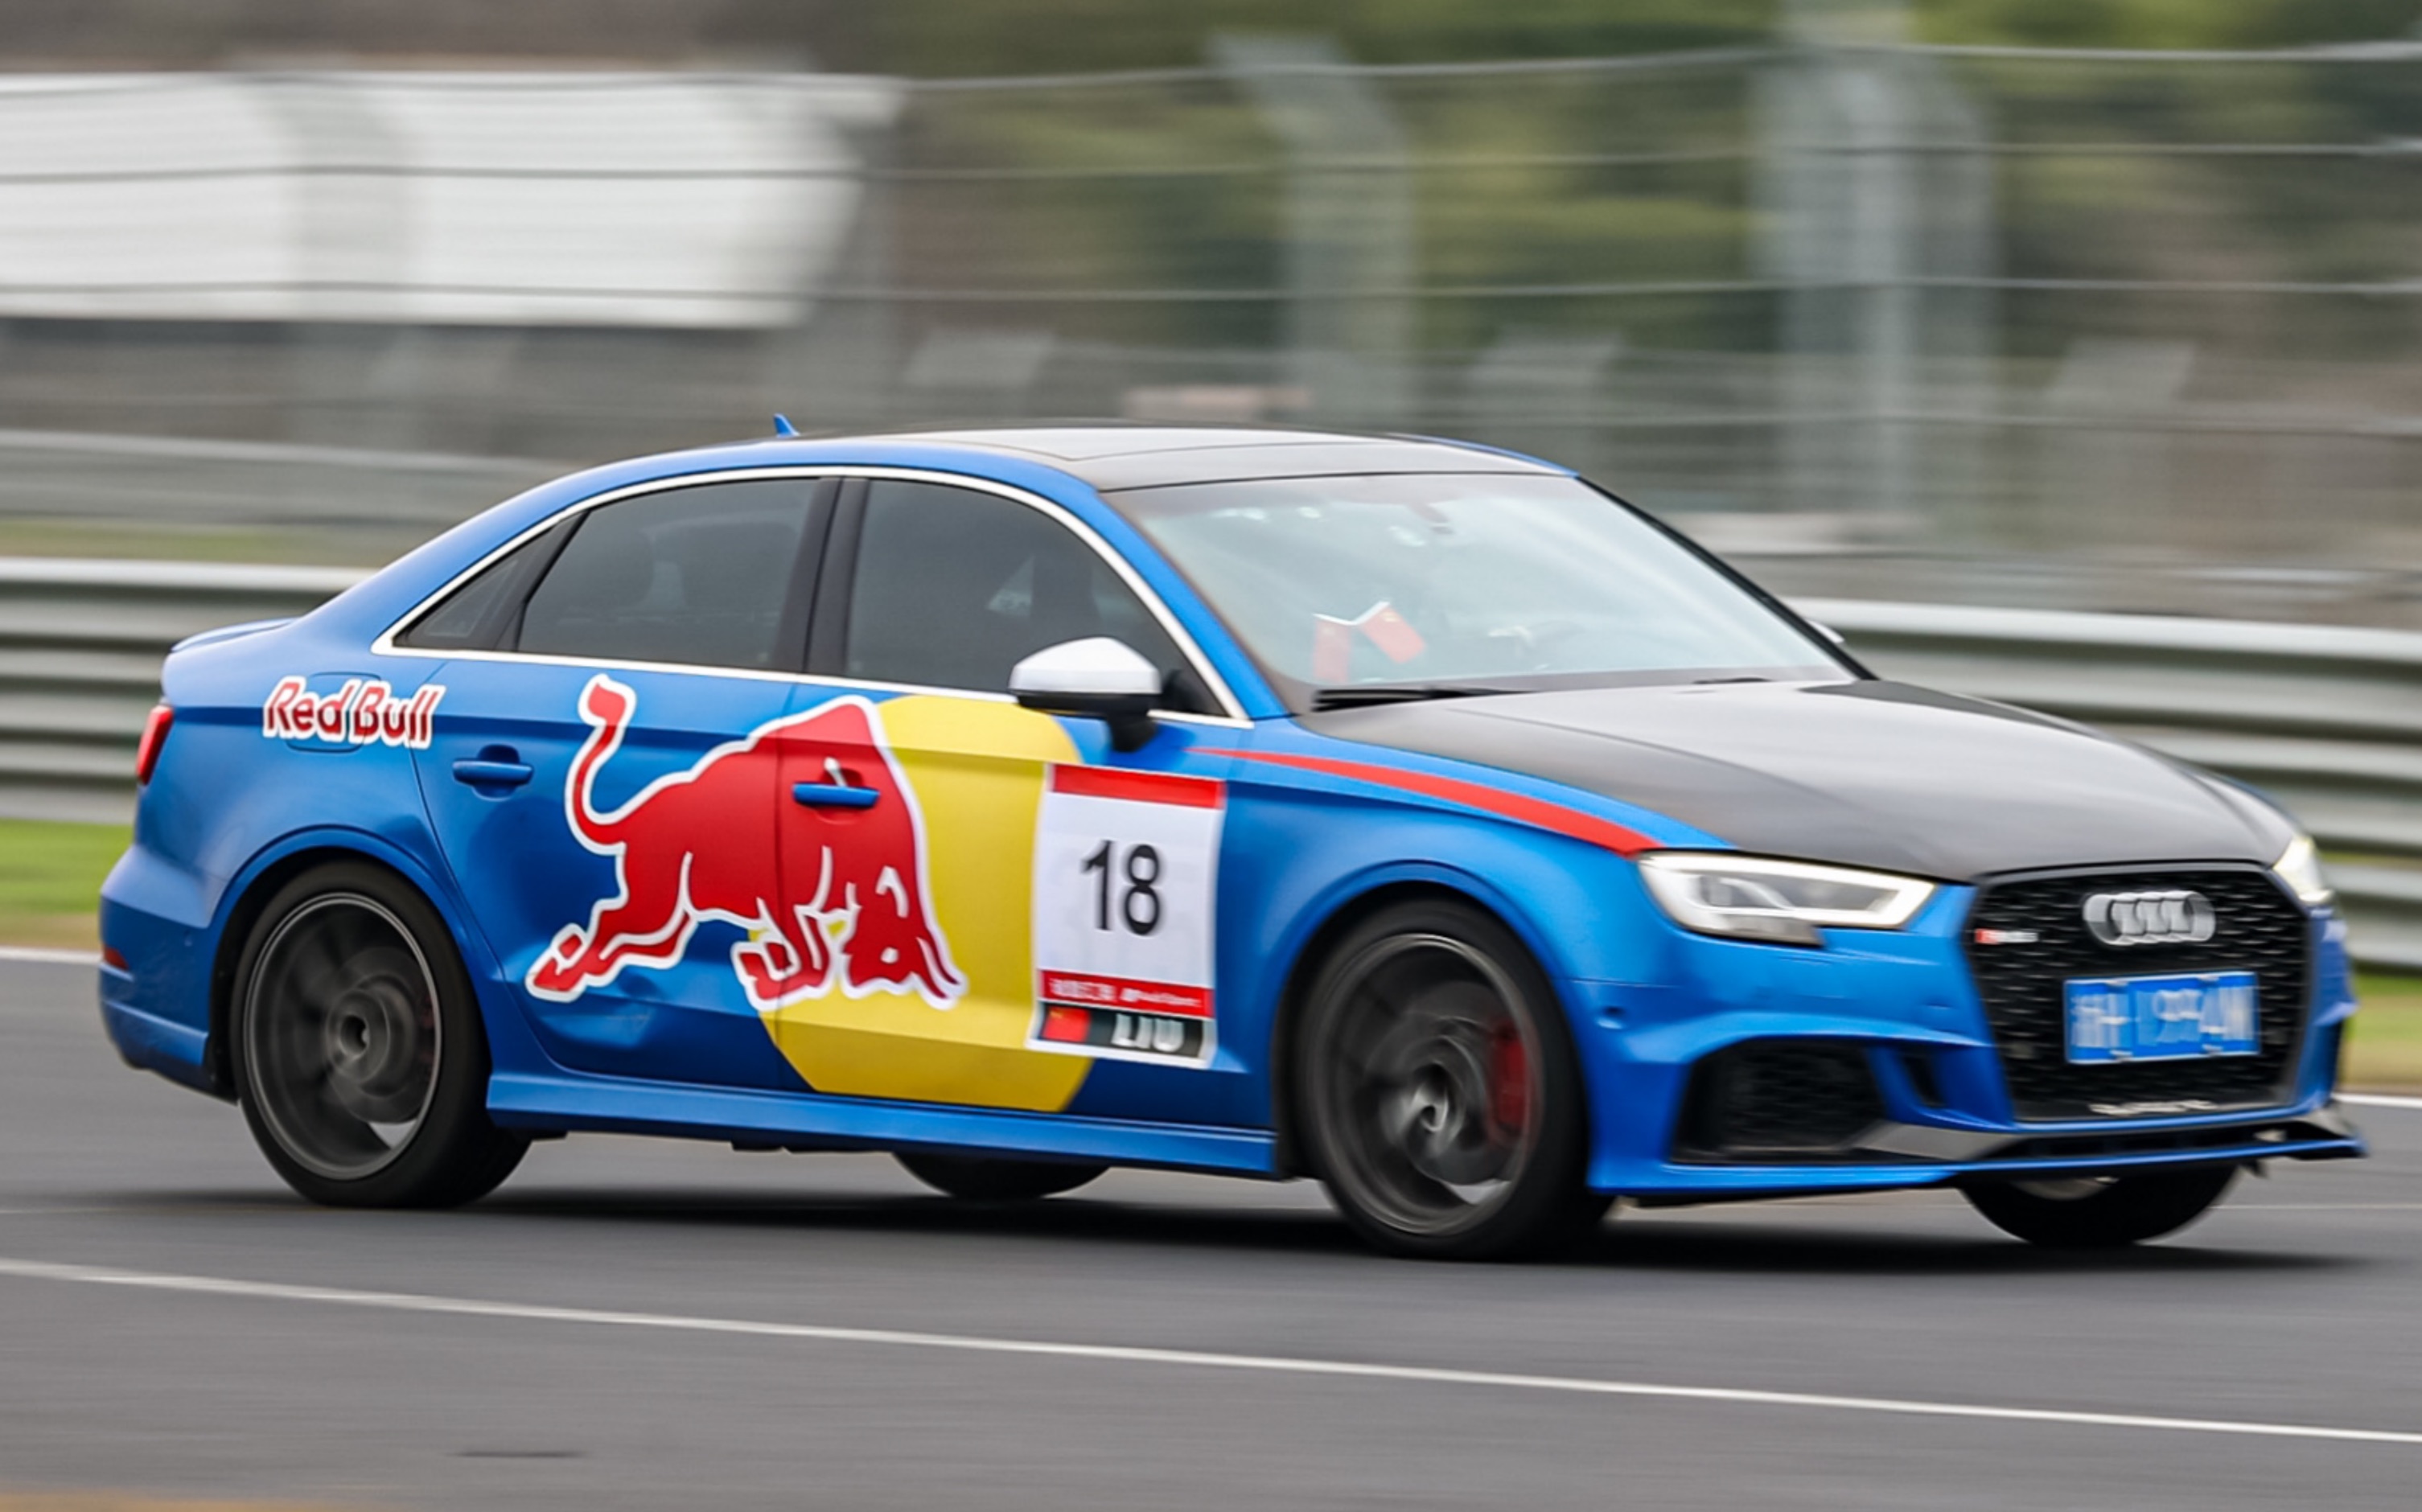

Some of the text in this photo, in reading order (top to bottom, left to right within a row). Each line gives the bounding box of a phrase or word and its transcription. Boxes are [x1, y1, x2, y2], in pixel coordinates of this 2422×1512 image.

[265, 679, 442, 746] Red Bull
[1082, 839, 1161, 935] 18
